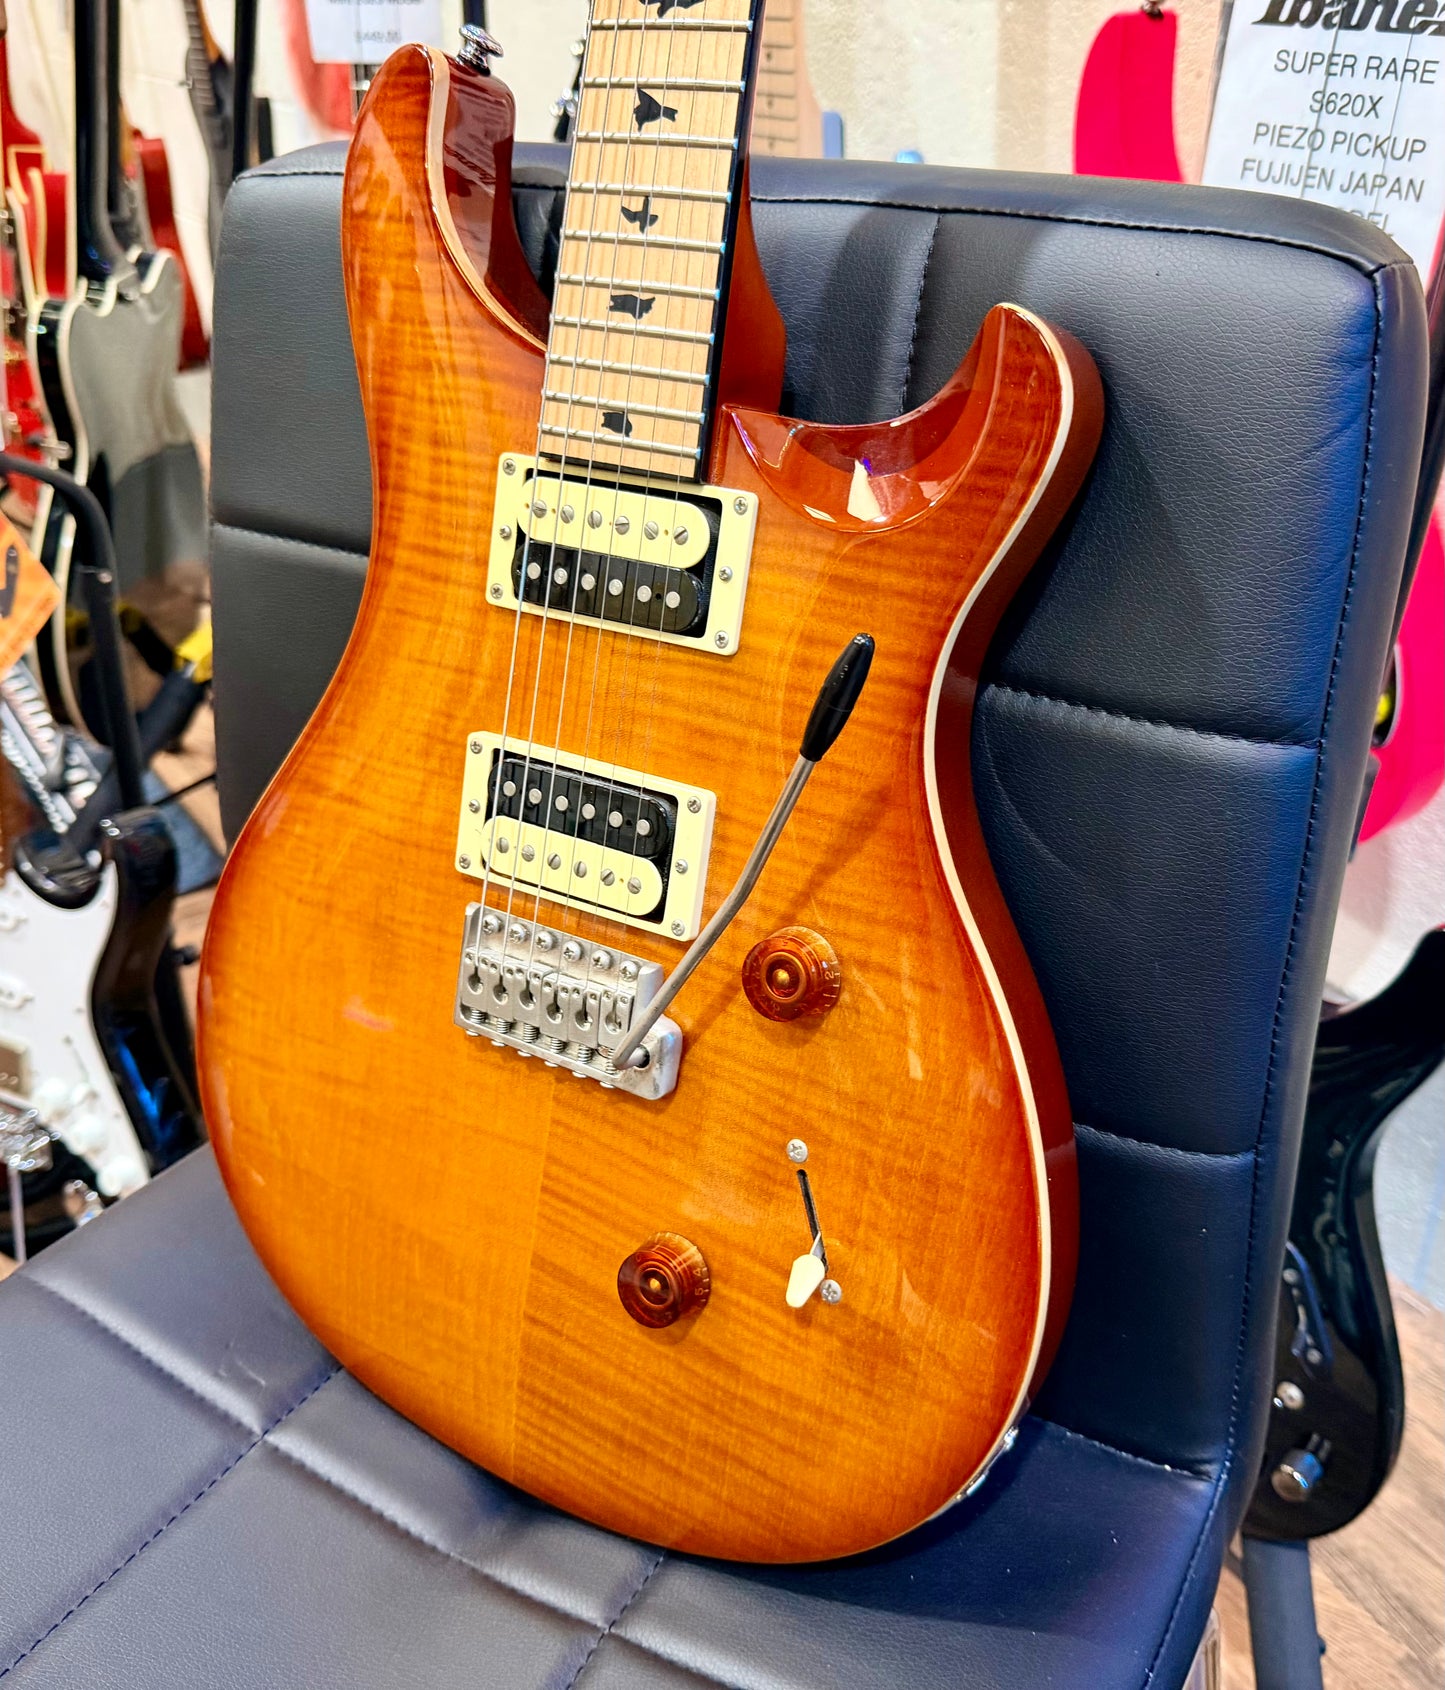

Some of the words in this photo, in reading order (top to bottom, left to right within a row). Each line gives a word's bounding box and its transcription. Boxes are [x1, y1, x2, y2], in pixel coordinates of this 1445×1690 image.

[1273, 49, 1358, 78] SUPER
[1364, 55, 1440, 84] RARE
[1309, 90, 1383, 119] S620X
[1253, 122, 1325, 152] PIEZO
[1330, 130, 1427, 162] PICKUP
[1240, 158, 1335, 191] FUJIJEN
[1340, 171, 1425, 203] JAPAN
